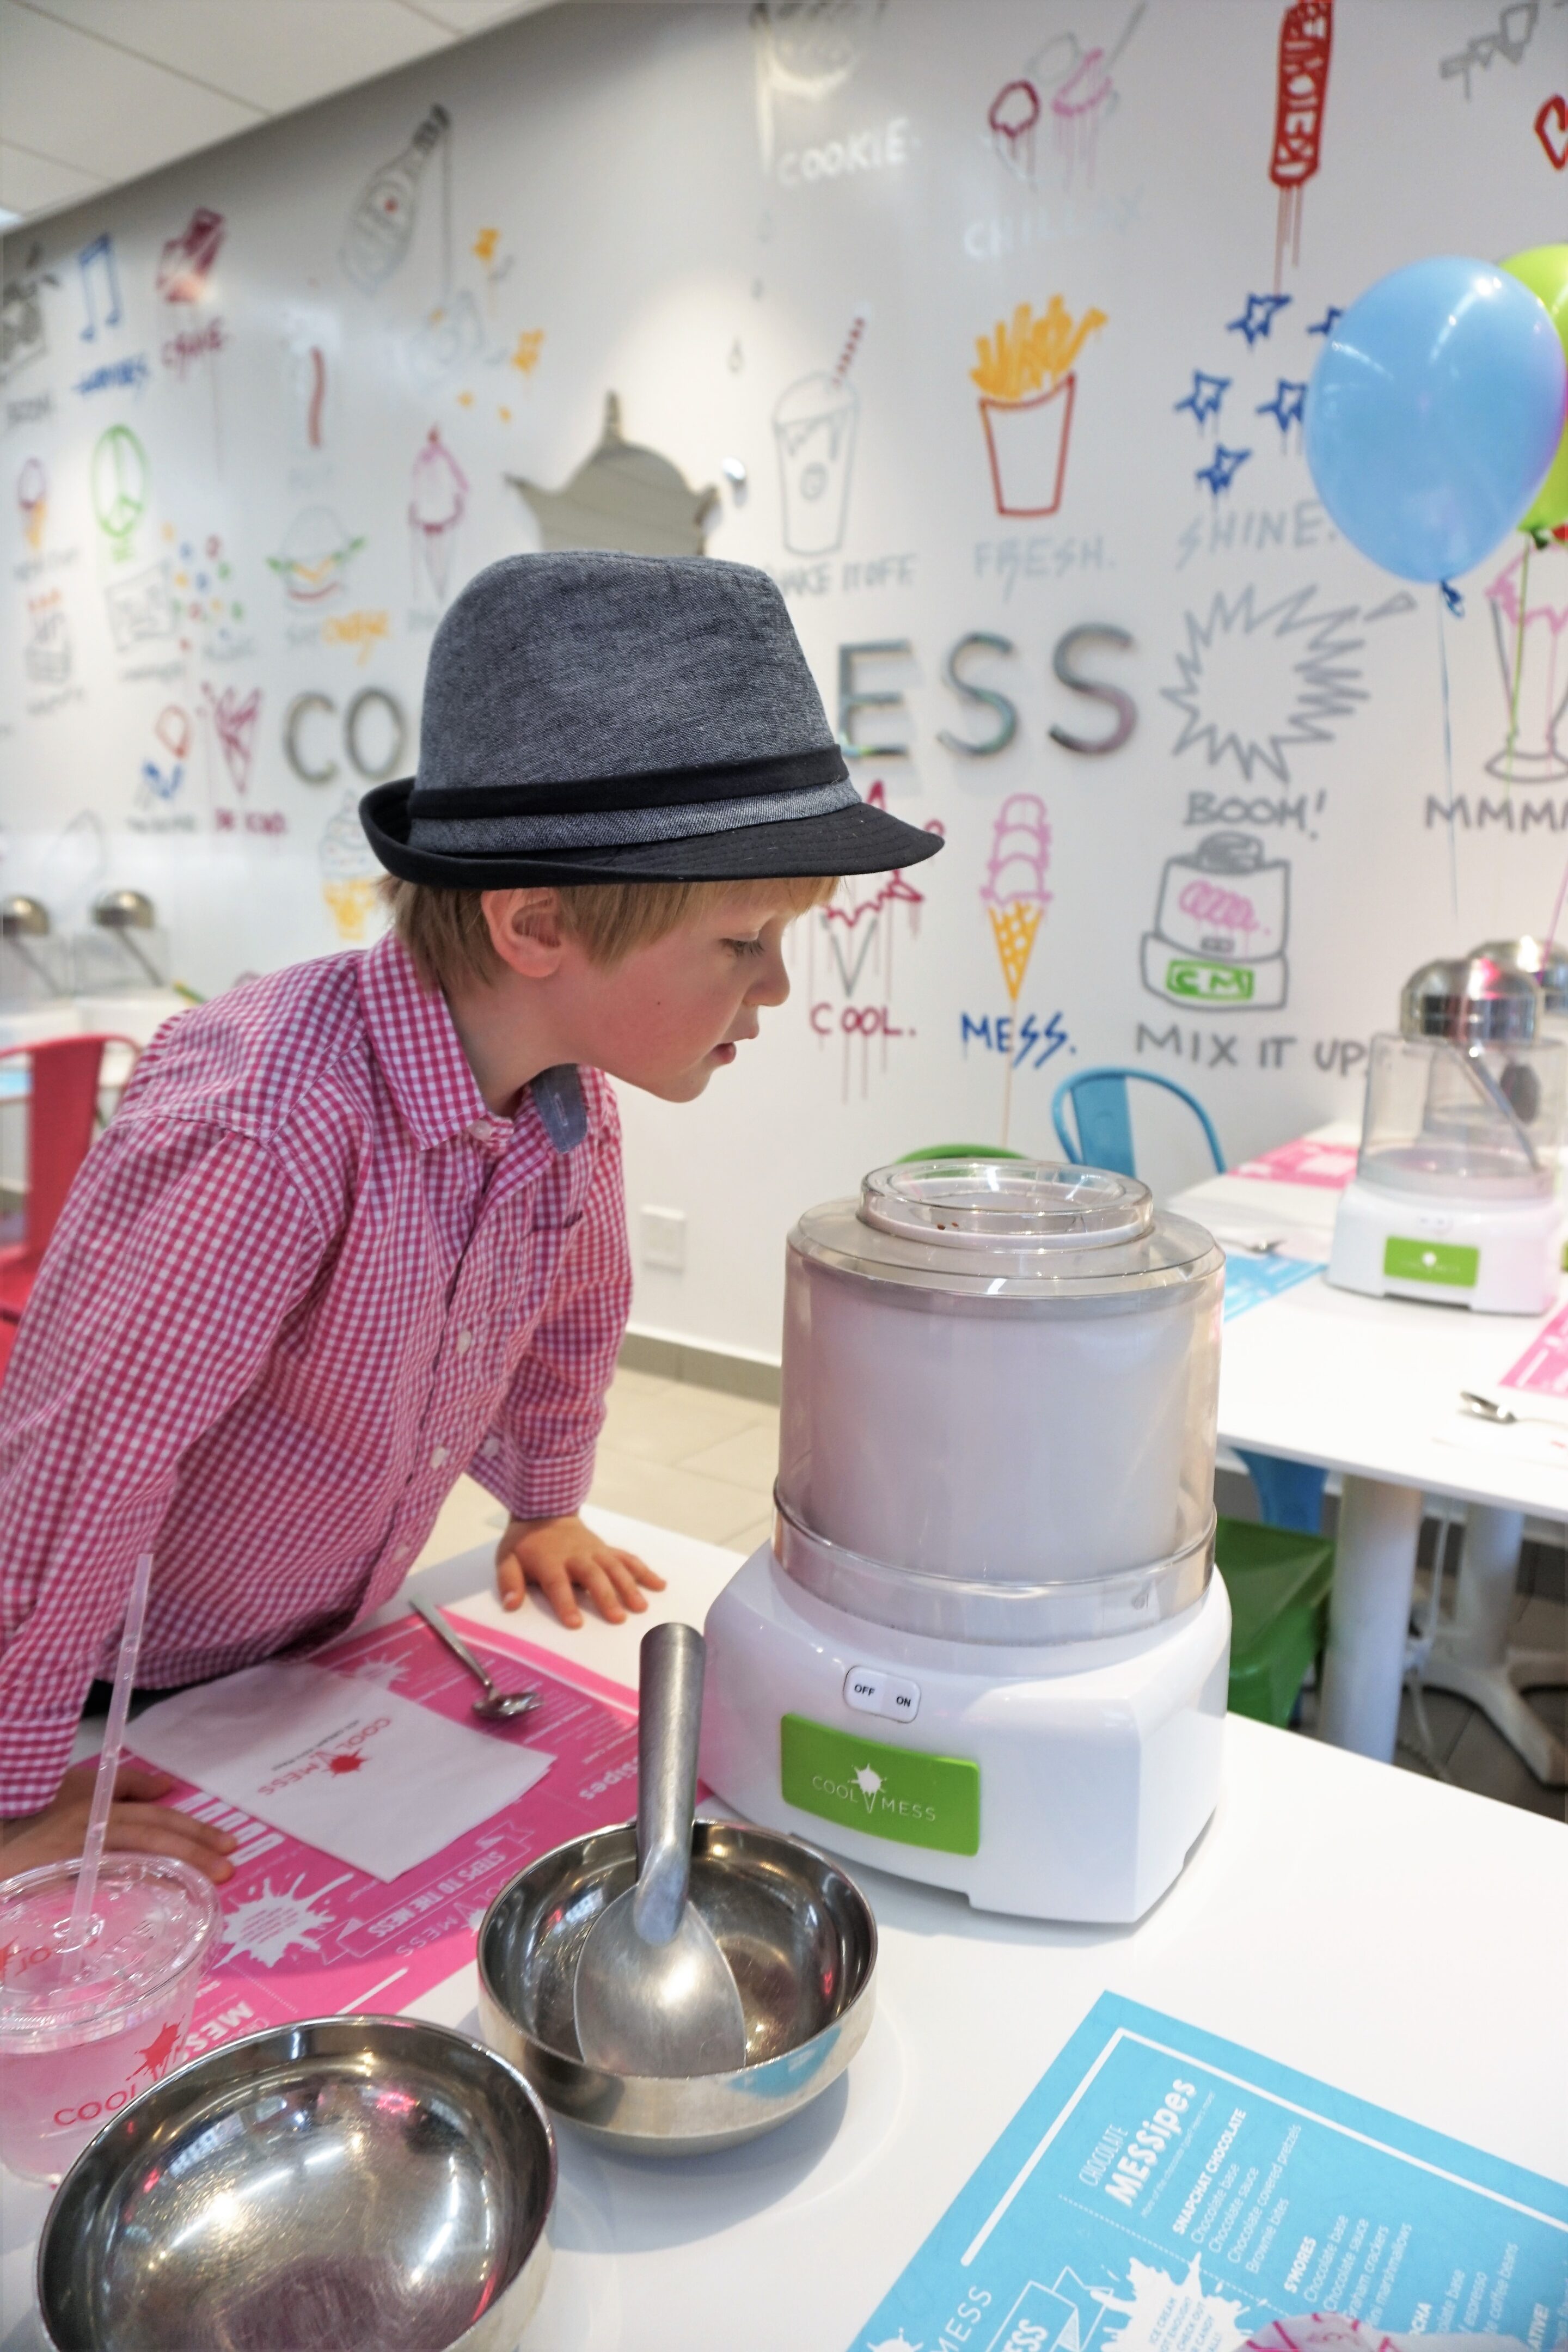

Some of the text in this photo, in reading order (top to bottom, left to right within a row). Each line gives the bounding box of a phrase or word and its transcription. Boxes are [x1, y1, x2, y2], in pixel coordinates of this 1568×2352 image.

[284, 621, 1137, 785] CO ESS
[1183, 789, 1327, 841] BOOM!
[810, 1002, 916, 1037] COOL.
[960, 1012, 1077, 1069] MESS.
[1137, 1021, 1238, 1069] MIX
[1259, 1036, 1298, 1069] IT
[854, 1683, 911, 1708] OFF ON
[336, 1717, 391, 1755] COOL
[258, 1756, 319, 1795] MESS
[812, 1775, 936, 1822] COOL MESS
[368, 1851, 506, 1937] STEPS TO THE MESS
[395, 1916, 458, 1961] MESS
[1079, 2125, 1128, 2186] CHOCOLATE
[1106, 2080, 1196, 2205] MESSipes
[1173, 2109, 1246, 2234] SNAPCHAT CHOCOLATE
[1227, 2124, 1302, 2264] Chocolate covered pretzels
[1190, 2163, 1240, 2244] Chocolate base
[1208, 2167, 1259, 2253] Chocolate sauce
[1245, 2197, 1290, 2274] Brownie bites
[1303, 2214, 1349, 2303] Chocolate base
[1364, 2225, 1389, 2274] crackers
[1375, 2222, 1413, 2305] marshmallows
[1284, 2236, 1316, 2293] S'MORES
[1322, 2218, 1369, 2313] Chocolate sauce
[1445, 2269, 1466, 2299] base
[1408, 2302, 1432, 2339] CHA
